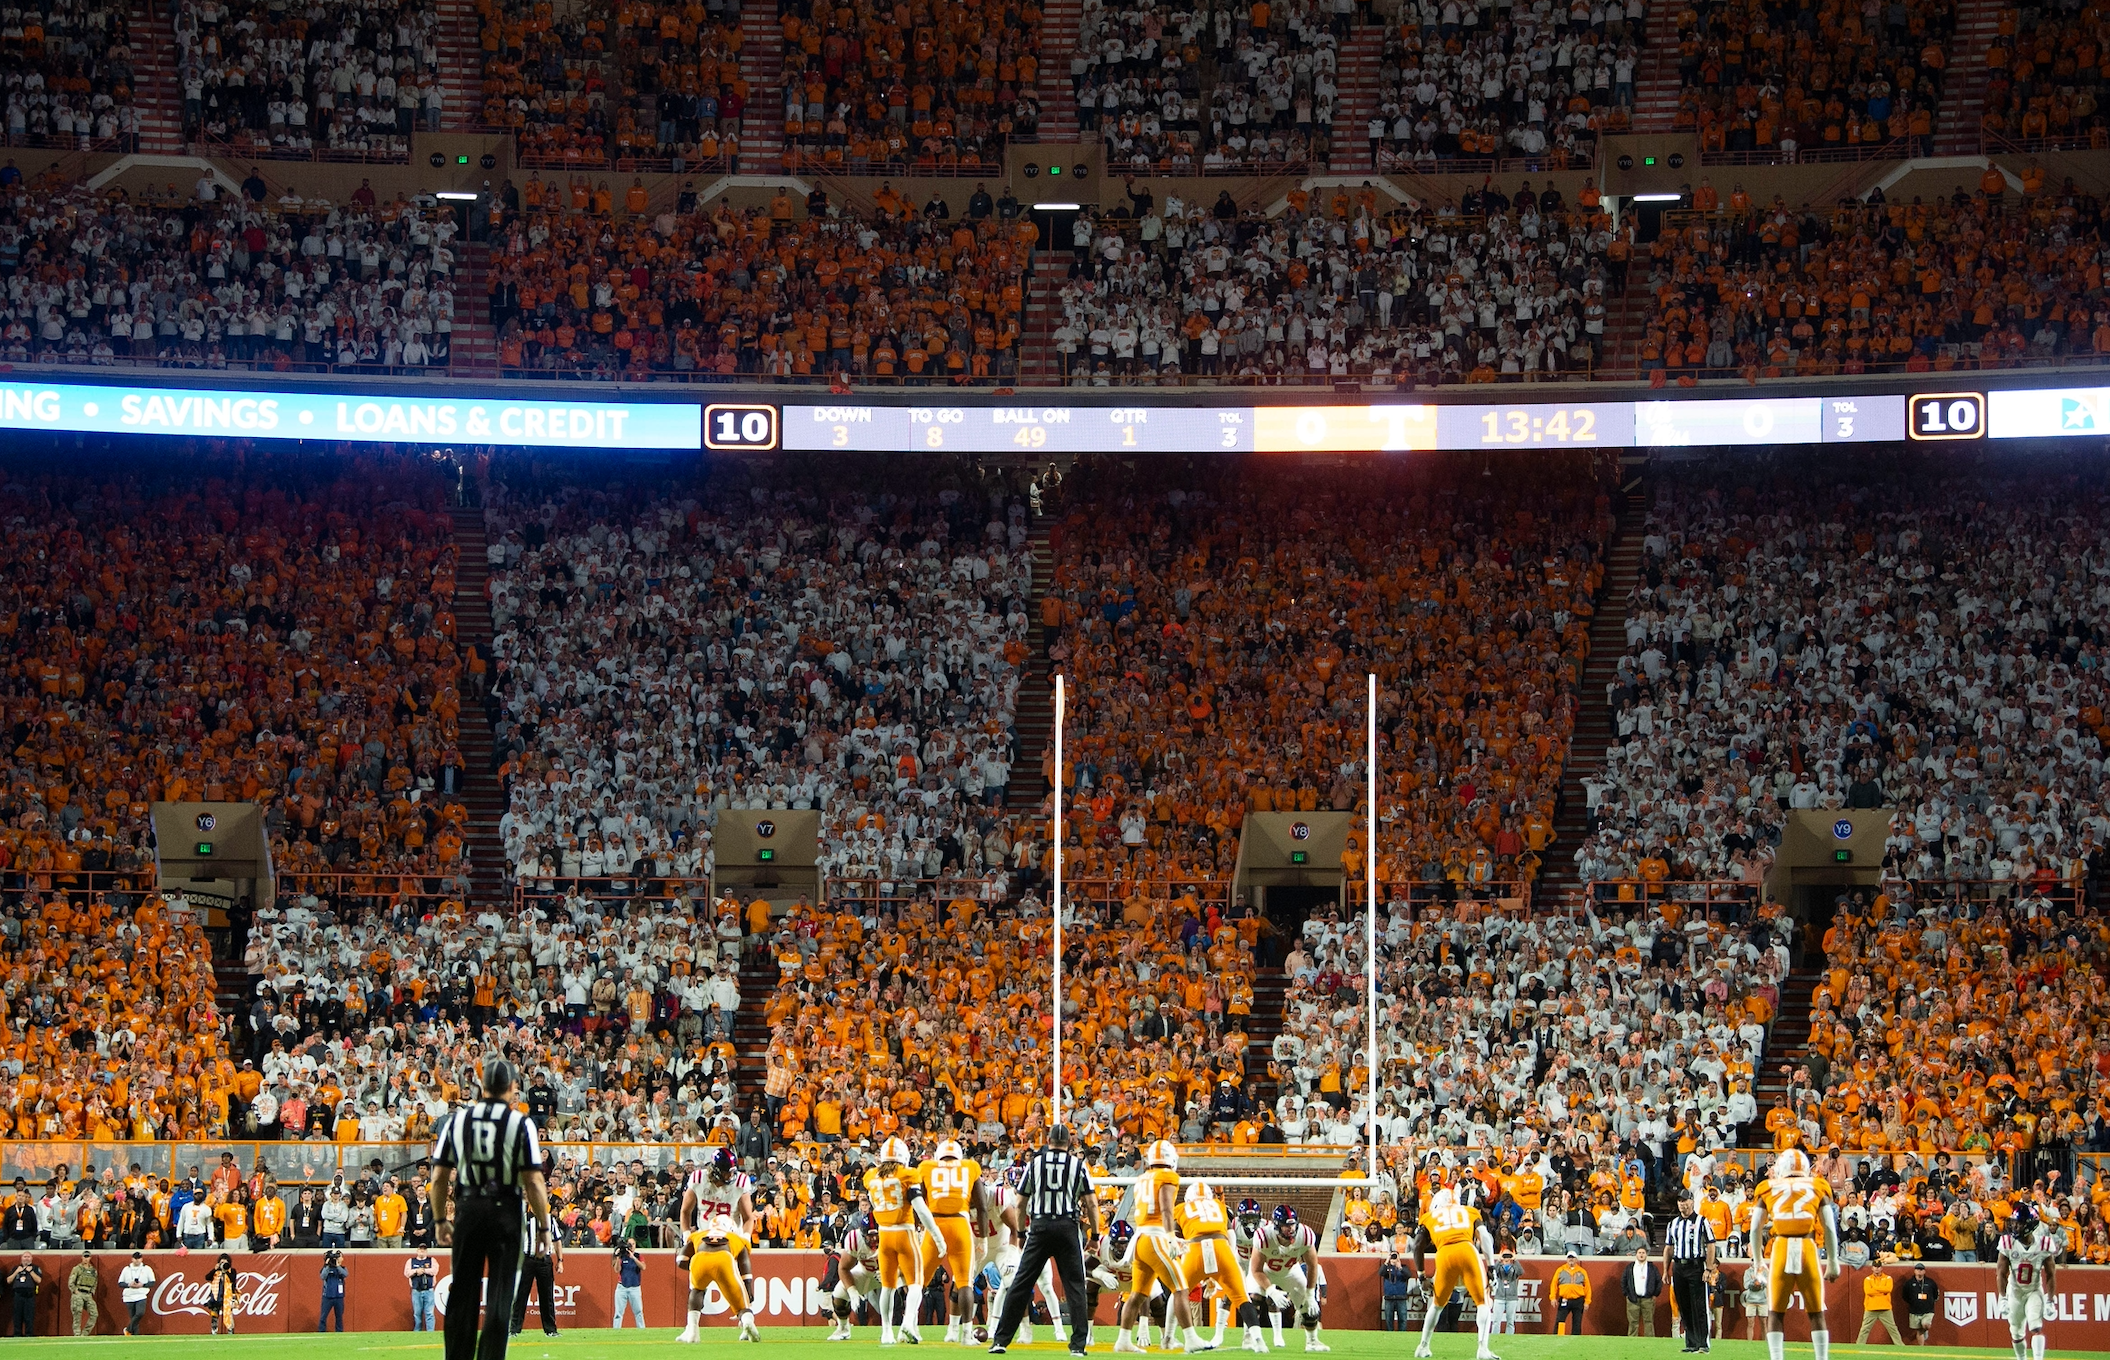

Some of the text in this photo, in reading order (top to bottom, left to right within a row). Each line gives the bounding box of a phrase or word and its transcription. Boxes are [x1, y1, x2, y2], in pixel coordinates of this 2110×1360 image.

[121, 394, 279, 430] SAVINGS
[814, 407, 872, 423] DOWN
[908, 408, 964, 424] TO GO
[993, 409, 1070, 424] BALL ON
[1110, 409, 1147, 424] QTR
[1218, 412, 1244, 424] TOL
[1832, 401, 1858, 413] TOL
[1921, 401, 1976, 431] 10
[336, 402, 629, 440] LOANS & CREDIT
[716, 412, 769, 442] 10
[1295, 410, 1327, 445] 0
[1369, 404, 1425, 450] T
[1481, 409, 1597, 443] 13:42
[1742, 404, 1774, 438] 0
[1836, 417, 1854, 438] 3
[832, 426, 849, 446] 3
[926, 426, 944, 447] 8
[1014, 426, 1047, 447] 49
[1122, 426, 1137, 446] 1
[1221, 427, 1239, 448] 3
[198, 817, 213, 827] Y6
[759, 824, 774, 834] Y7
[1292, 826, 1308, 836] Y8
[1835, 824, 1851, 834] Y9
[761, 850, 772, 859] EXIT
[472, 1121, 497, 1162] B
[931, 1167, 969, 1199] 94
[1045, 1163, 1065, 1190] U
[869, 1178, 903, 1212] 33
[1771, 1183, 1815, 1220] 22
[702, 1199, 731, 1221] 78
[1185, 1199, 1224, 1223] 48
[1432, 1206, 1470, 1233] 30
[1268, 1257, 1298, 1272] 64
[2016, 1263, 2034, 1285] 0
[151, 1272, 288, 1316] Cocaola
[701, 1276, 880, 1316] DUNK
[1986, 1291, 2088, 1322] MCLE
